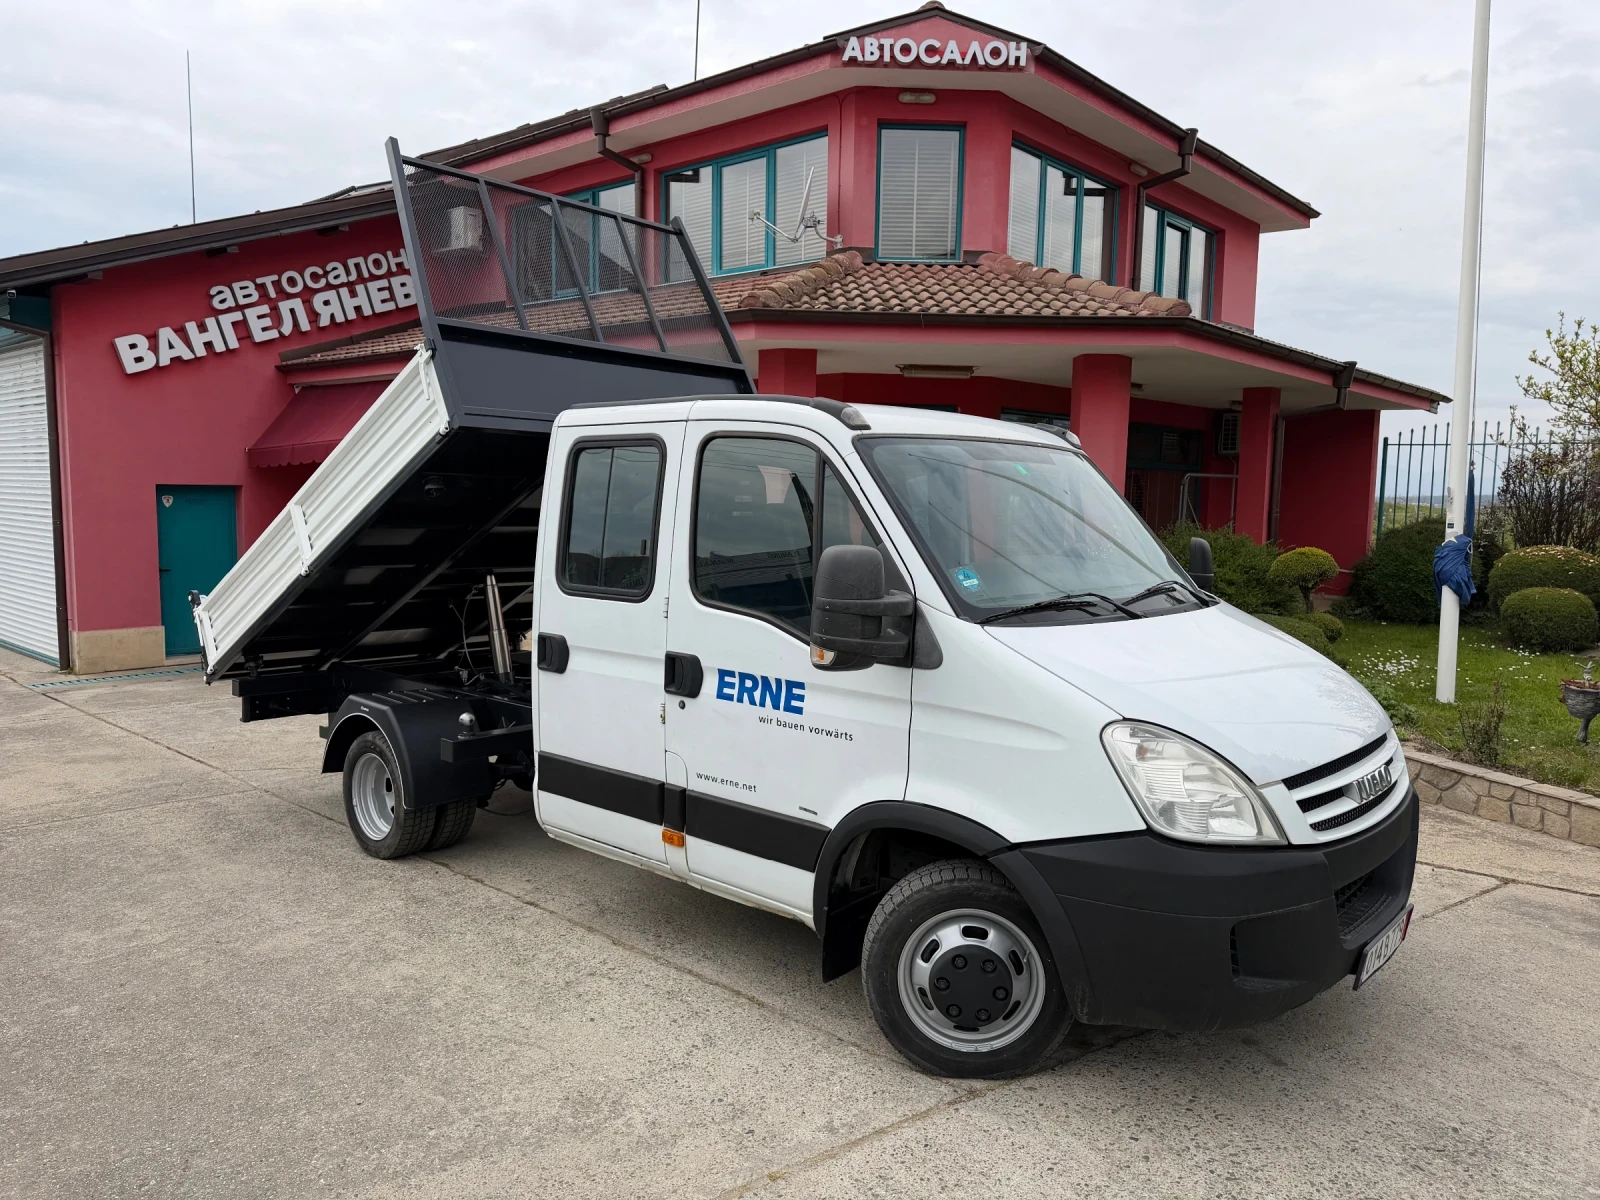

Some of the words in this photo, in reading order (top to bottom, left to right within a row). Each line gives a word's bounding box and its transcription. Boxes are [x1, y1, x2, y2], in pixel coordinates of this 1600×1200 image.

[842, 36, 1028, 69] АВТОСАЛОН
[208, 248, 410, 311] автосалон
[112, 297, 311, 375] ВАНГЕЛ
[311, 274, 418, 328] ЯНЕВ
[716, 668, 806, 716] ERNE
[758, 715, 774, 726] wir
[776, 717, 805, 732] bauen
[808, 724, 854, 742] vorwärts
[696, 772, 757, 793] www.erne.net
[1353, 764, 1392, 805] IVECO
